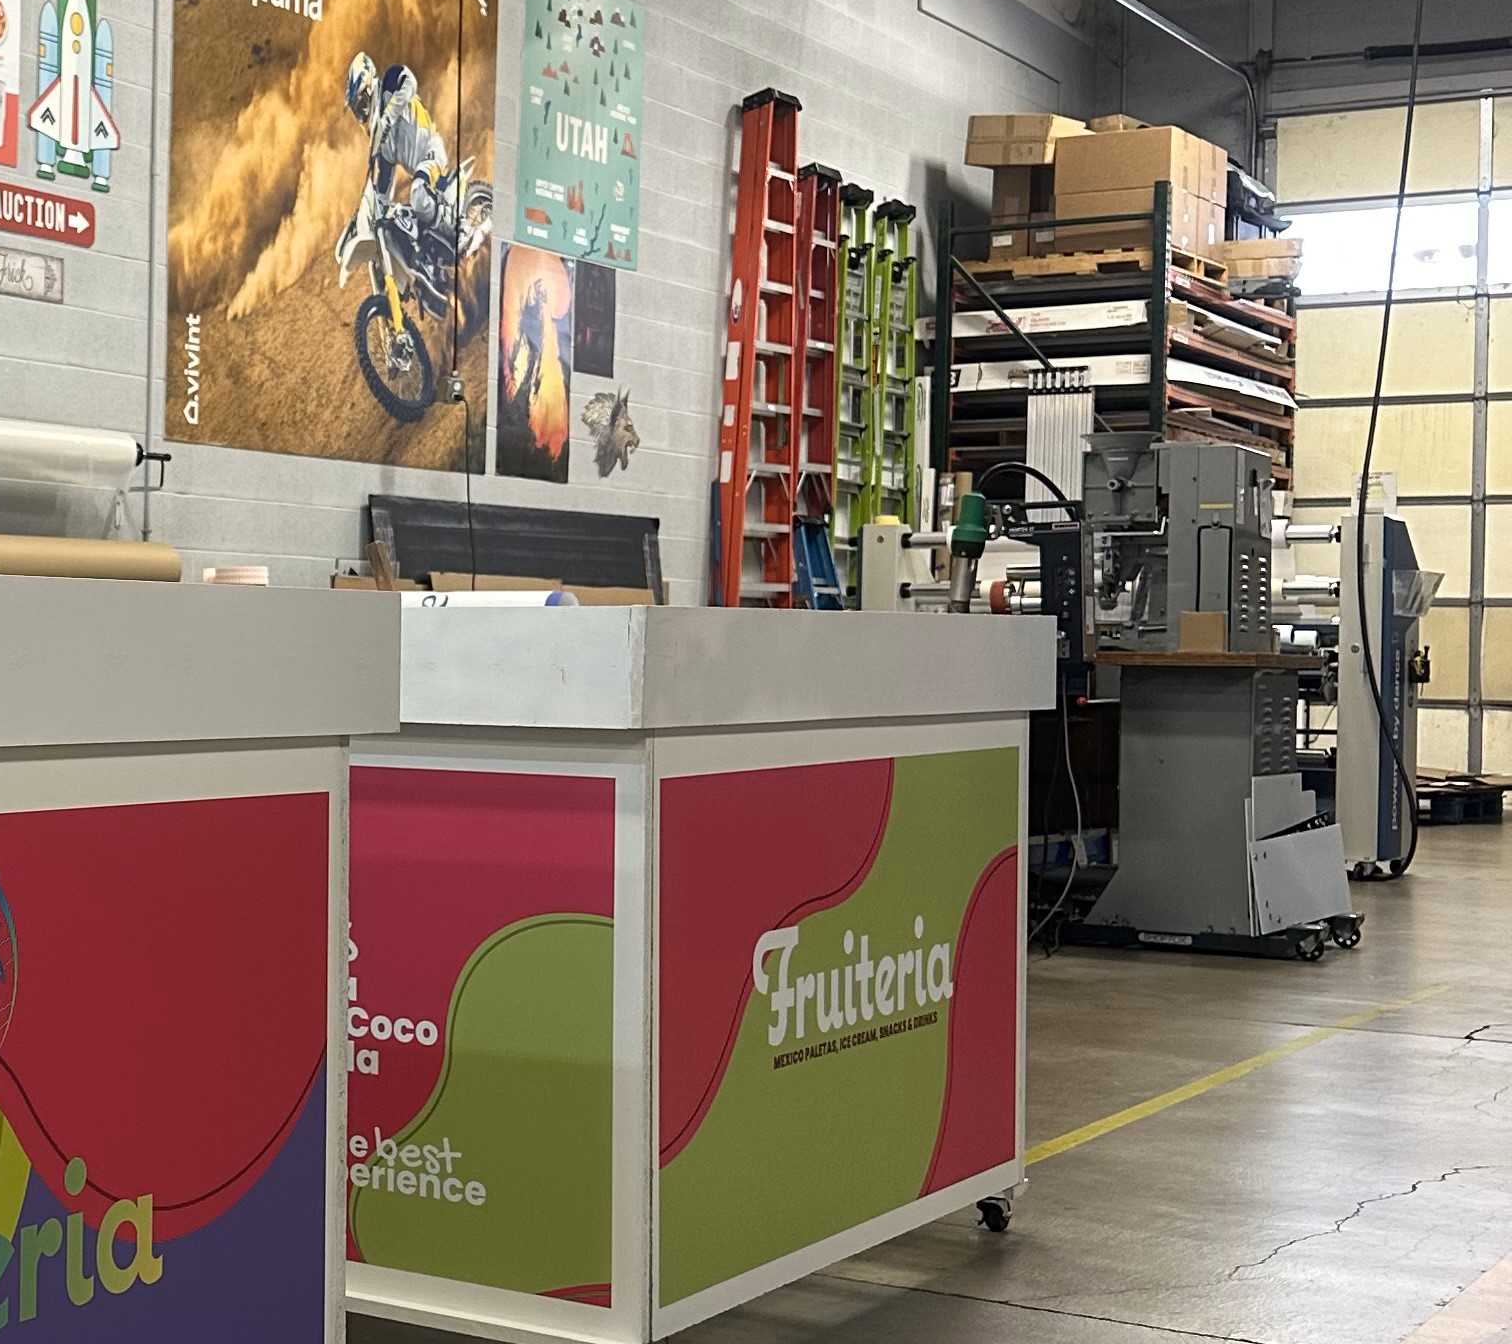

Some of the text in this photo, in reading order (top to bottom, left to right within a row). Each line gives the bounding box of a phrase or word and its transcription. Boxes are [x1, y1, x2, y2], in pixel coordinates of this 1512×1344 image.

[555, 110, 609, 165] UTAH
[752, 914, 954, 1047] Fruiteria
[773, 1048, 804, 1070] MEXICO
[804, 1039, 838, 1061] PALETAS,
[839, 1037, 851, 1052] ICE
[851, 1028, 878, 1048] CREAM,
[879, 1021, 907, 1039] SNACKS
[913, 1011, 938, 1028] DRINKS
[374, 1126, 462, 1174] best
[347, 1159, 487, 1207] erience
